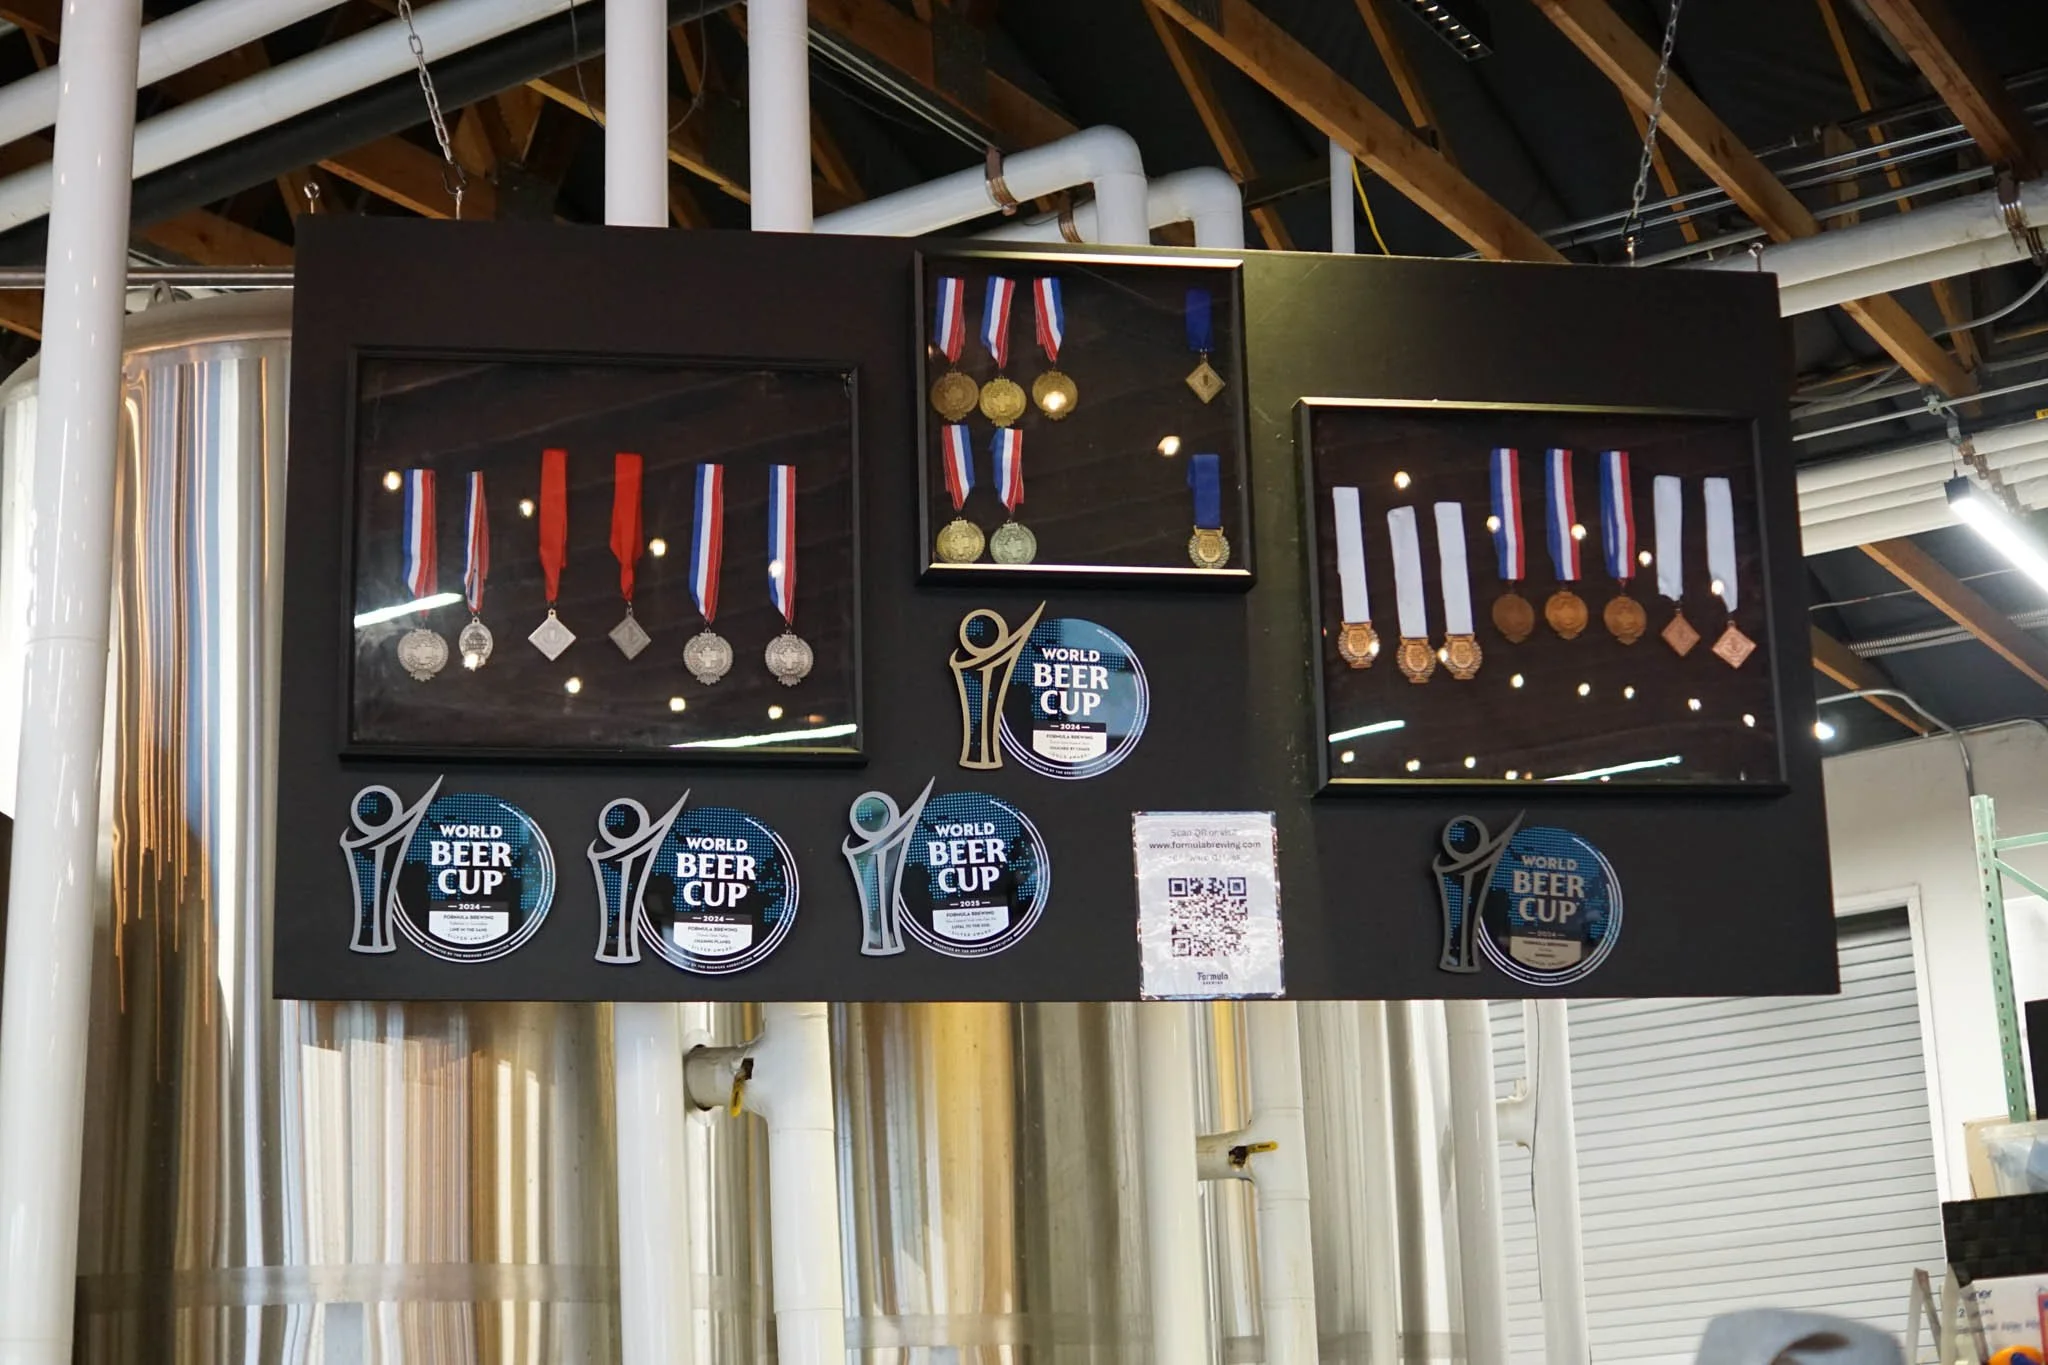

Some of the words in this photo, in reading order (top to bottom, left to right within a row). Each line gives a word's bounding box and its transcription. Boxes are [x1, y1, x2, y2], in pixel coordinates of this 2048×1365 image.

[1042, 648, 1100, 662] WORLD
[1034, 663, 1108, 690] BEER
[1040, 690, 1101, 716] CUP
[440, 825, 503, 839] WORLD
[935, 823, 995, 837] WORLD
[431, 841, 512, 867] BEER
[686, 837, 748, 852] WORLD
[928, 838, 1007, 866] BEER
[1149, 841, 1261, 850] www.formulabrewing.com
[676, 853, 756, 880] BEER
[1521, 855, 1578, 871] WORLD
[437, 869, 504, 895] CUP
[938, 866, 999, 893] CUP
[1512, 870, 1585, 898] BEER
[683, 881, 748, 907] CUP
[1519, 898, 1578, 924] CUP
